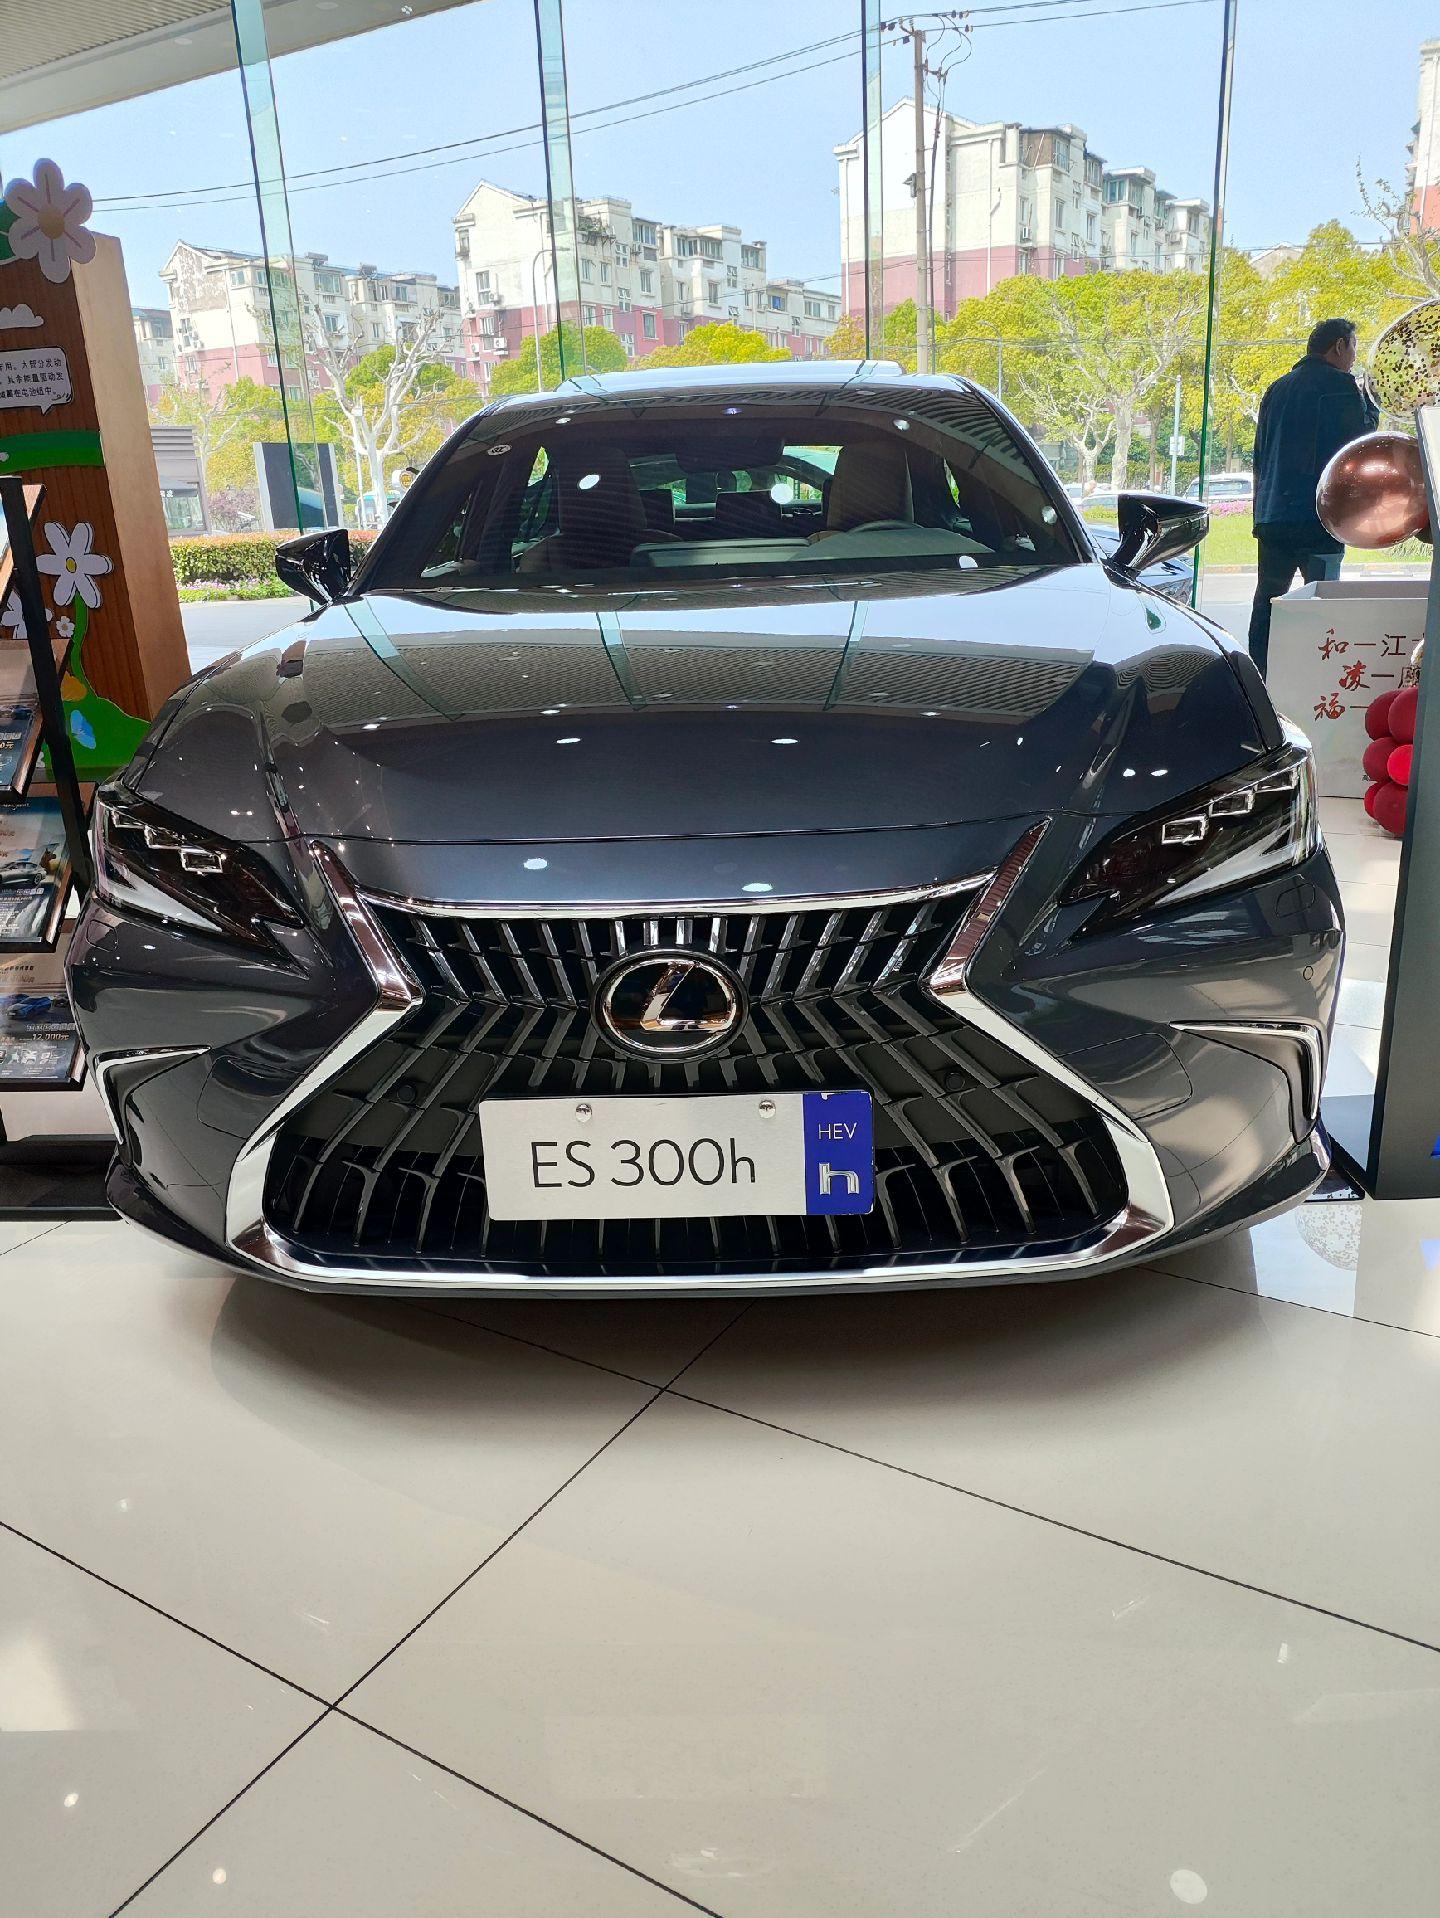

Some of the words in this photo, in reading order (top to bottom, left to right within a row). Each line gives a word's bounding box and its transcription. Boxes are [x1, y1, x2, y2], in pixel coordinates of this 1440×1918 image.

[818, 1122, 857, 1140] HEV
[531, 1140, 596, 1189] ES
[610, 1137, 757, 1188] 300h
